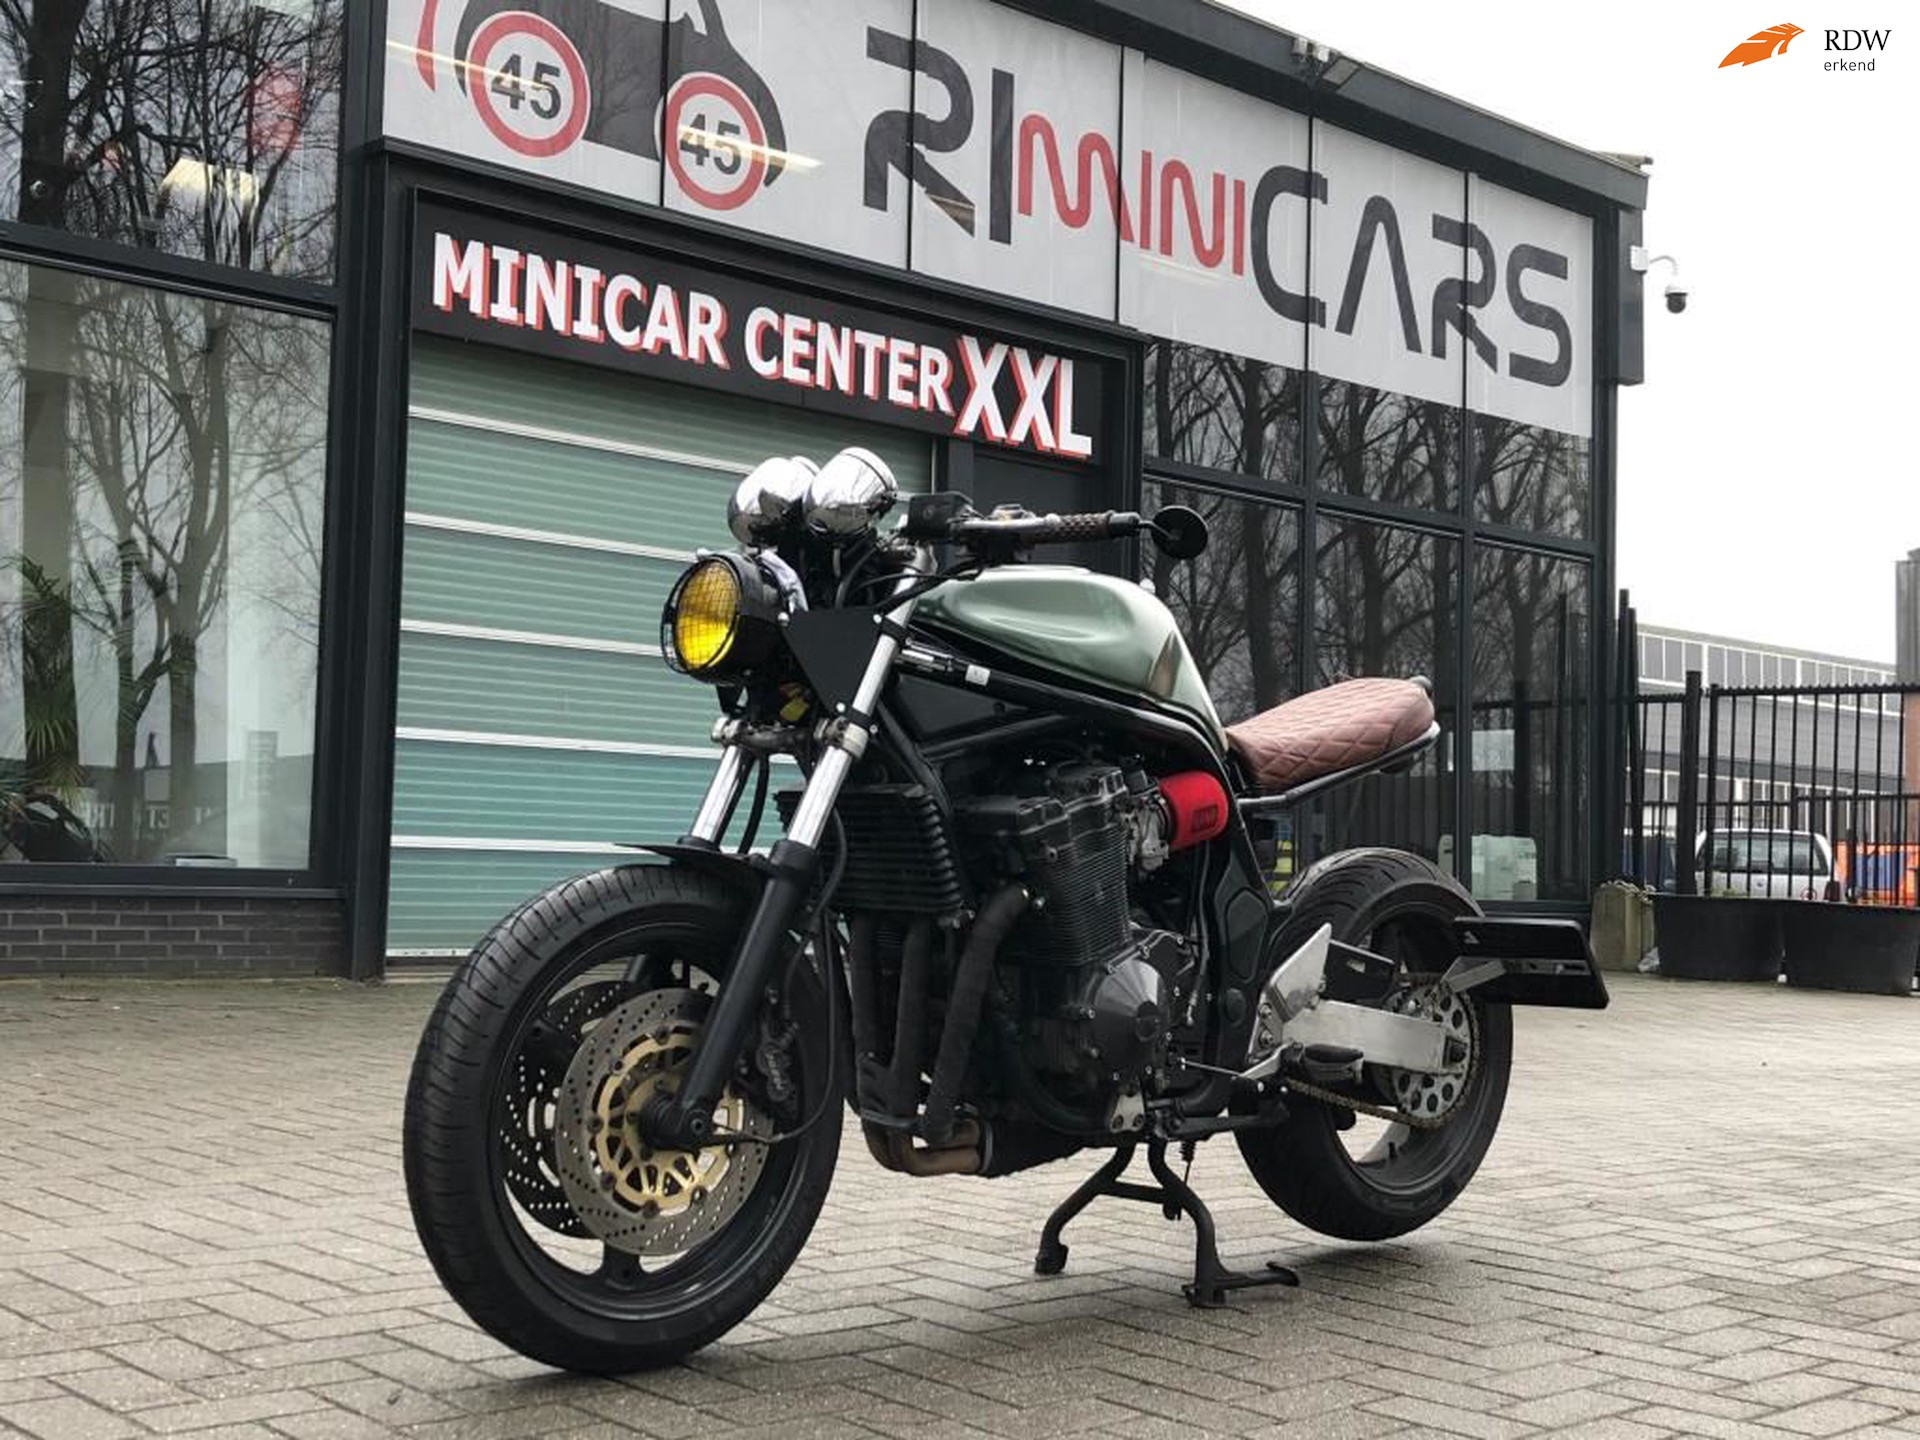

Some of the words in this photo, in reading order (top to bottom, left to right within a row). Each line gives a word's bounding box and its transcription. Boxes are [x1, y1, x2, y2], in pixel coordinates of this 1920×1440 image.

[490, 53, 562, 121] 45
[678, 113, 742, 176] 45
[432, 232, 729, 369] MINICAR
[743, 306, 955, 416] CENTER
[954, 334, 1093, 458] XXL
